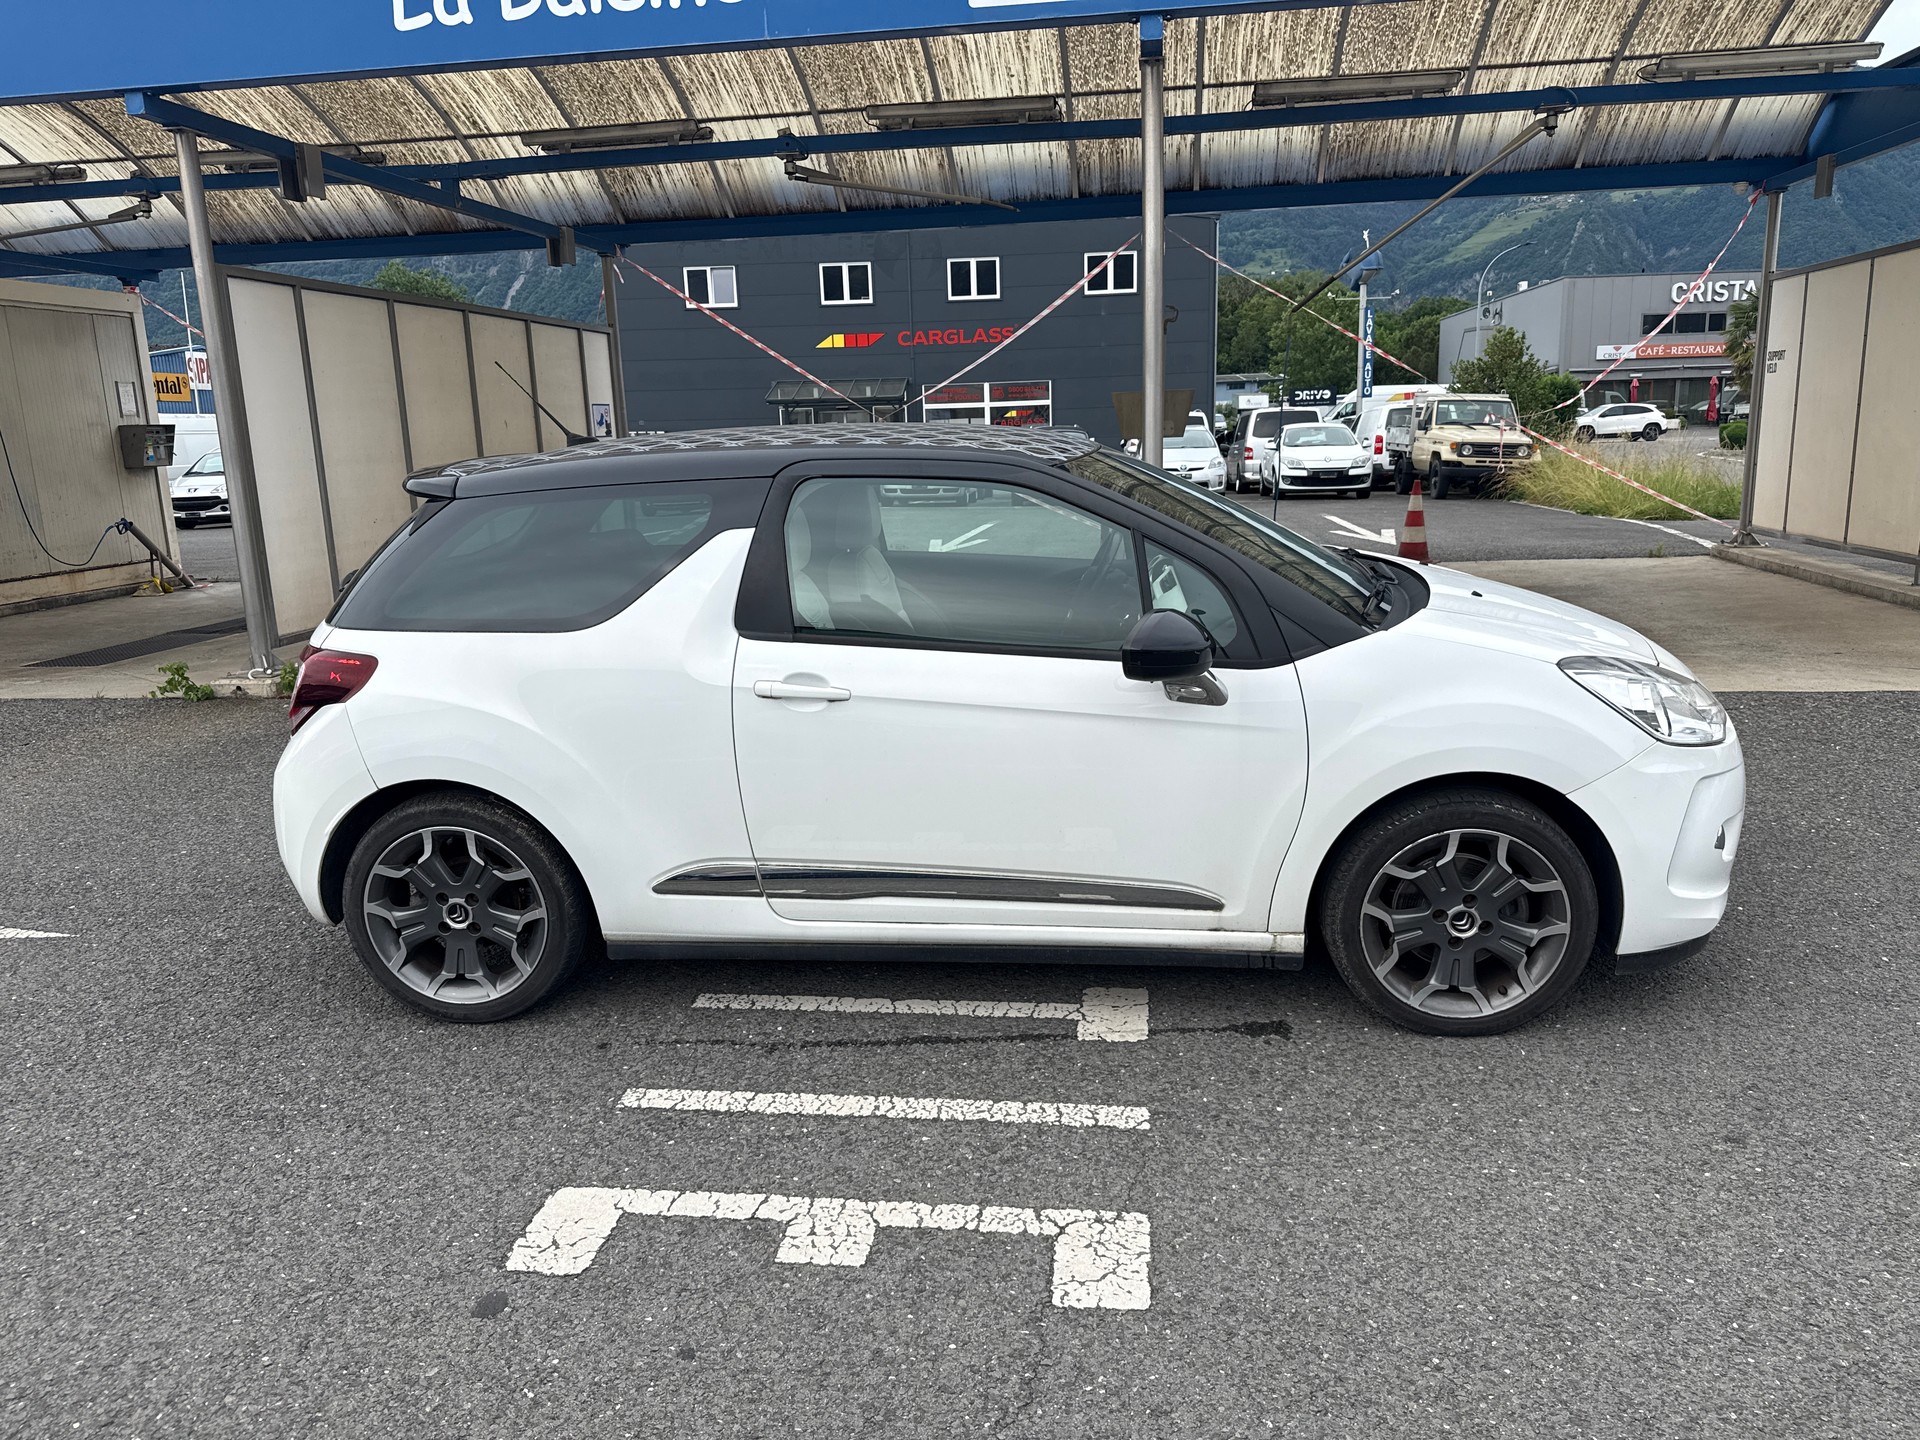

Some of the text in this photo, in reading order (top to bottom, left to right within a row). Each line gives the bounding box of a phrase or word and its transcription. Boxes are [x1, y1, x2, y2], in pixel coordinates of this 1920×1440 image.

[1671, 279, 1758, 304] CRISTA
[897, 327, 1014, 347] CARGLASS
[1767, 350, 1786, 361] SUPPORT
[1364, 362, 1372, 395] AUTO
